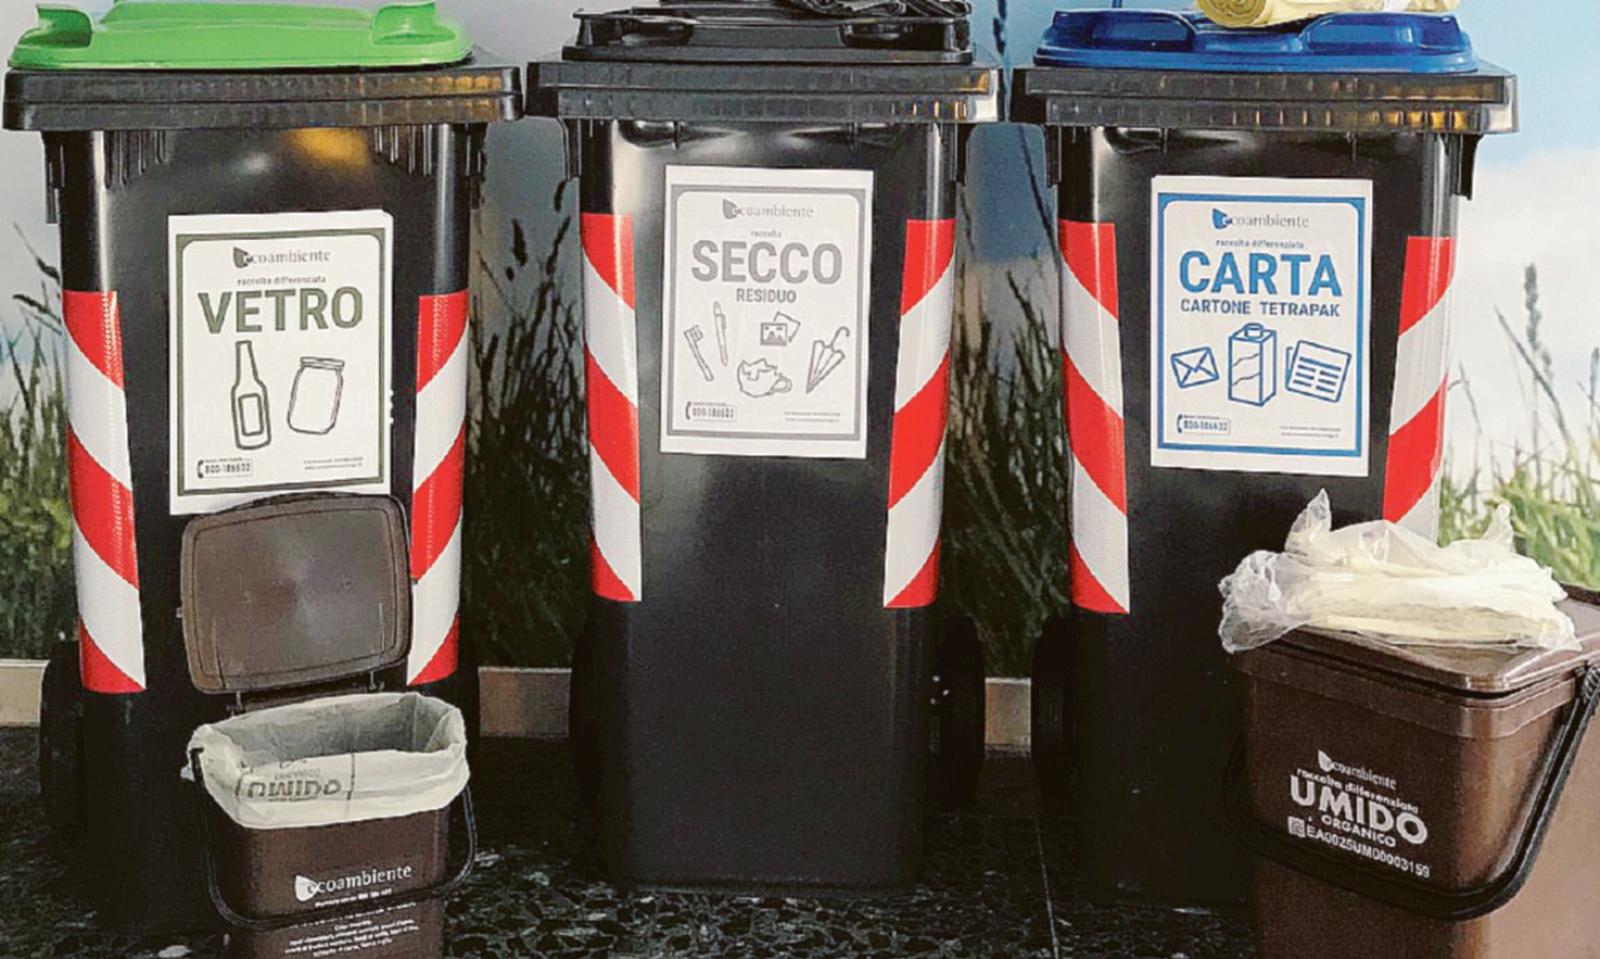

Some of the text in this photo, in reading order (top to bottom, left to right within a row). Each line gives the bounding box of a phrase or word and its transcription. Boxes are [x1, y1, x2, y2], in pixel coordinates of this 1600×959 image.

[691, 239, 843, 285] SECCO
[1179, 250, 1343, 297] CARTA
[197, 286, 364, 334] VETRO
[736, 287, 798, 304] RESIDUO
[1180, 298, 1341, 317] CARTONE TETRAPAK
[1296, 768, 1344, 791] raccolta
[1290, 774, 1429, 845] UMIDO
[1320, 814, 1397, 848] ORGANICO
